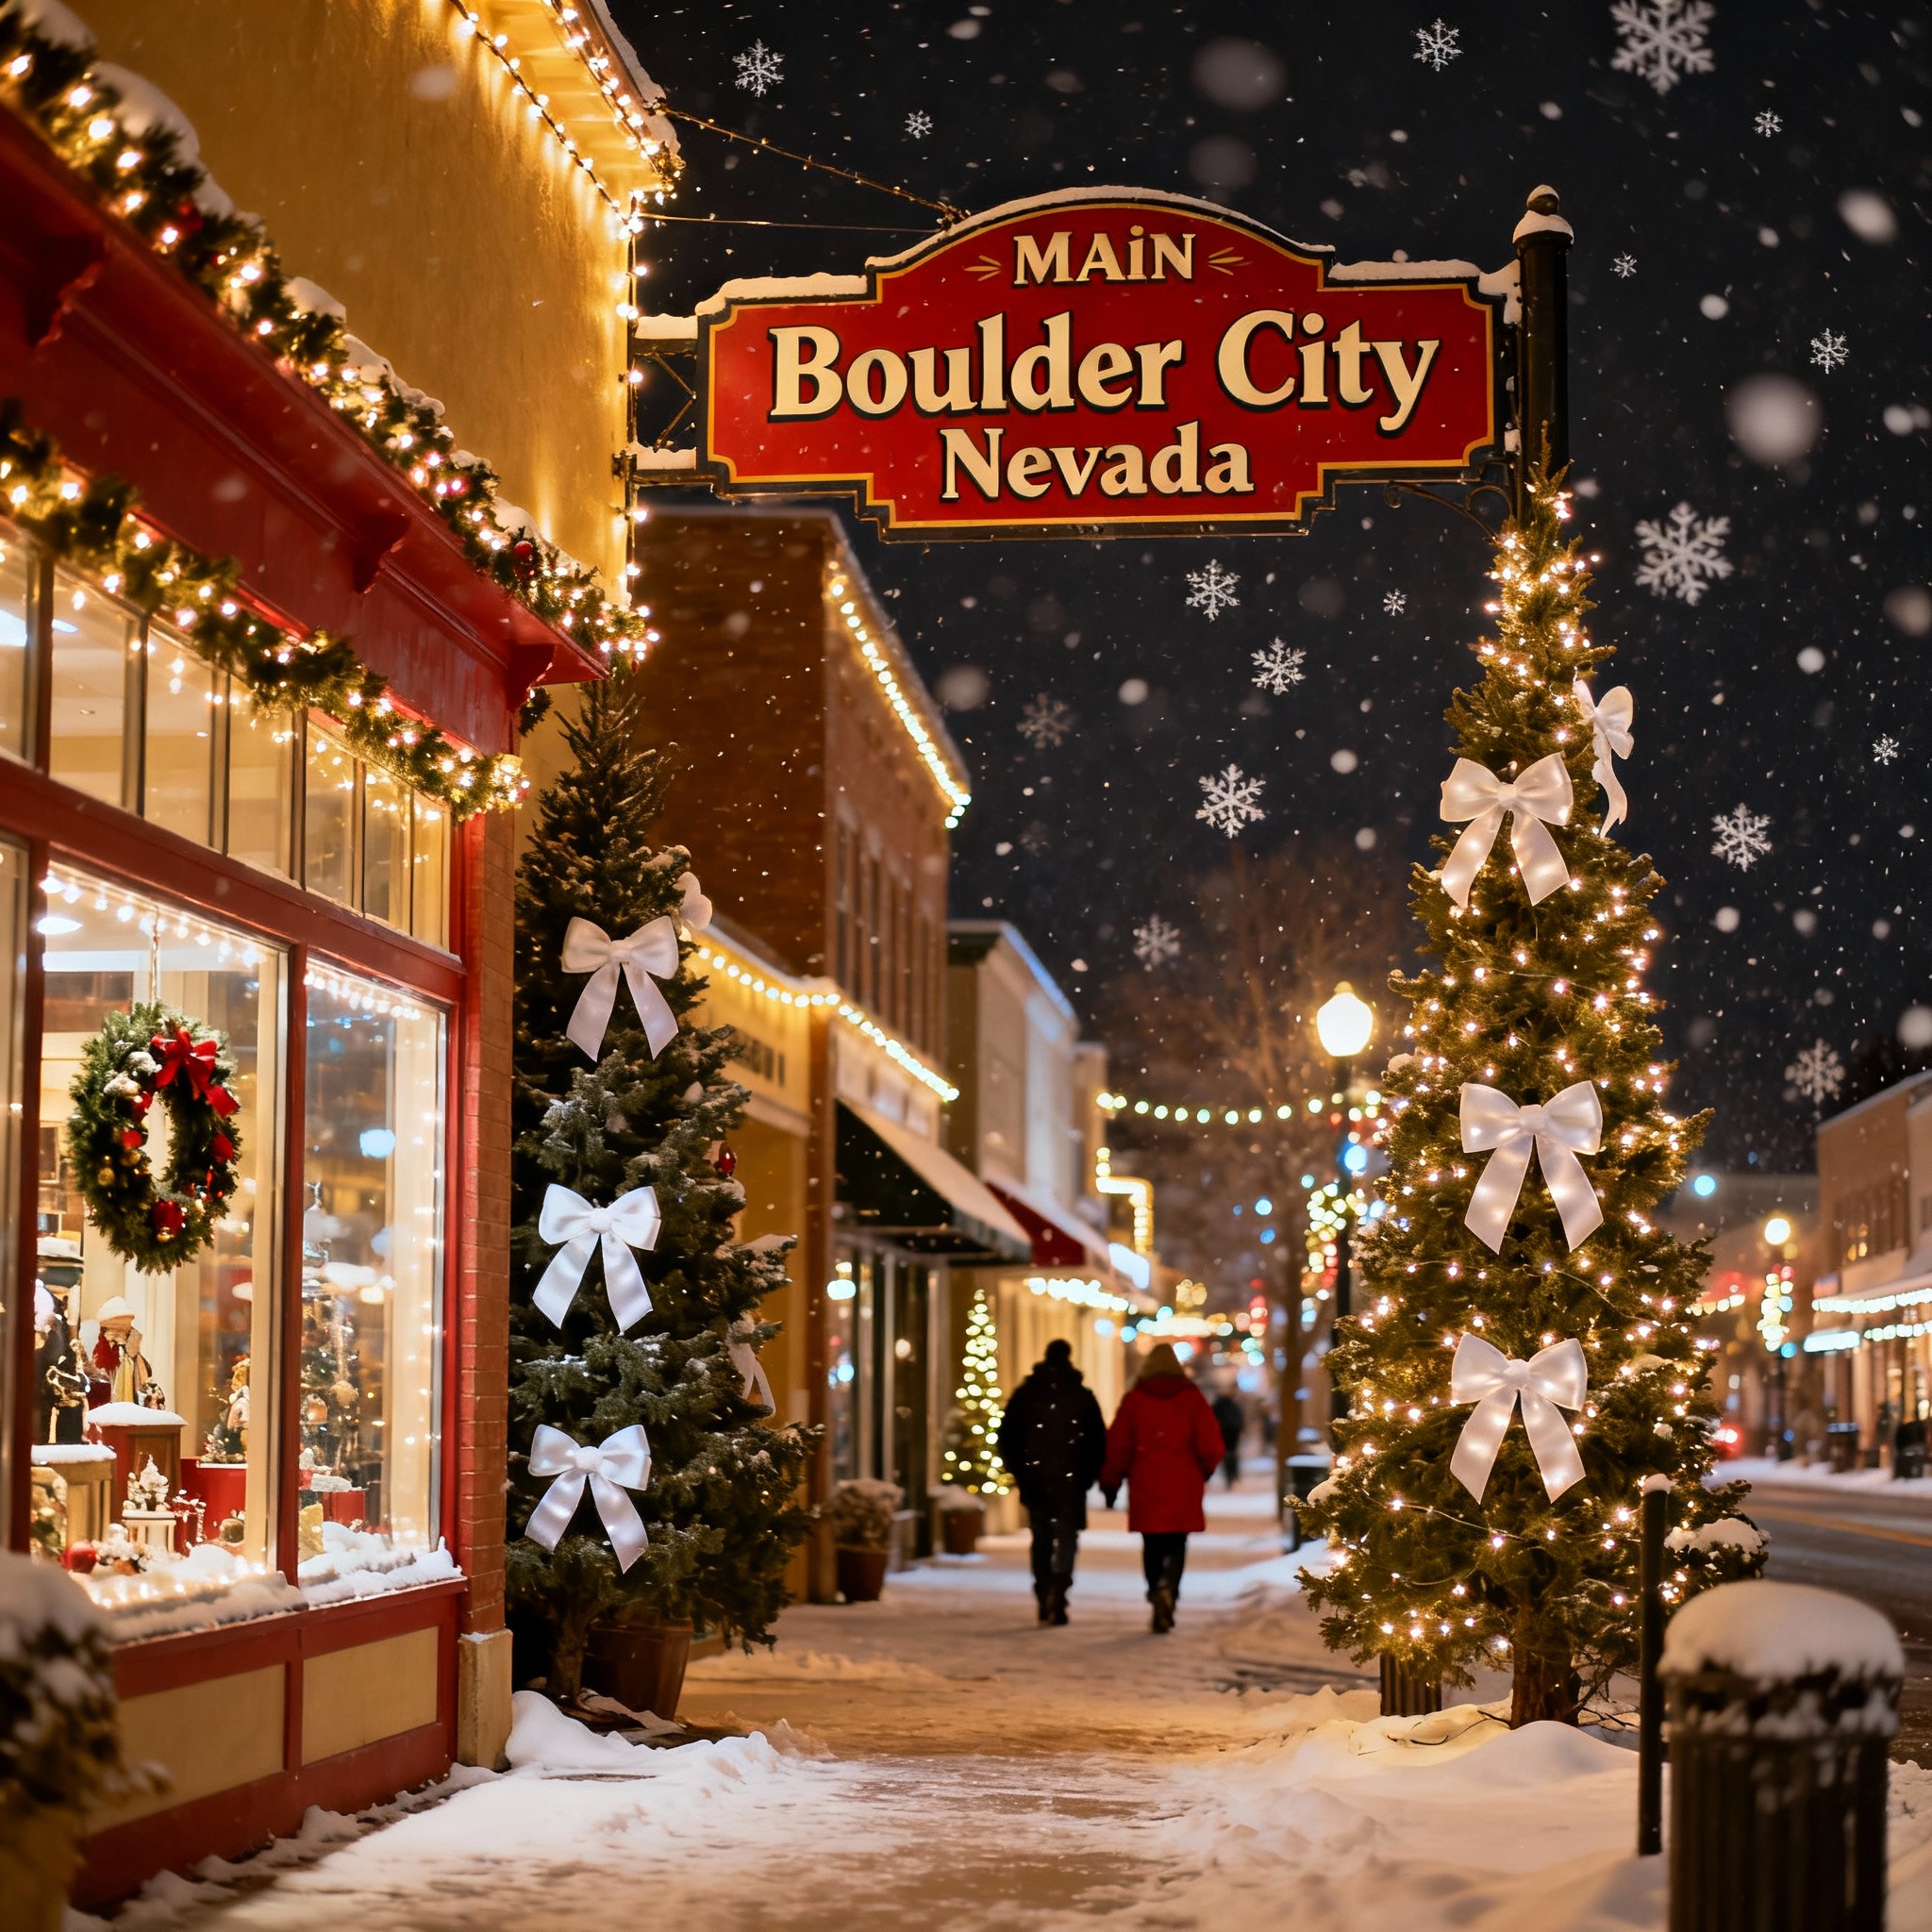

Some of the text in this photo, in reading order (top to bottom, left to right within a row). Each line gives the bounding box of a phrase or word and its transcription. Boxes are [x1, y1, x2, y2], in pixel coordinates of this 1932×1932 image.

[768, 309, 1441, 433] Boulder City
[939, 420, 1256, 500] Nevada
